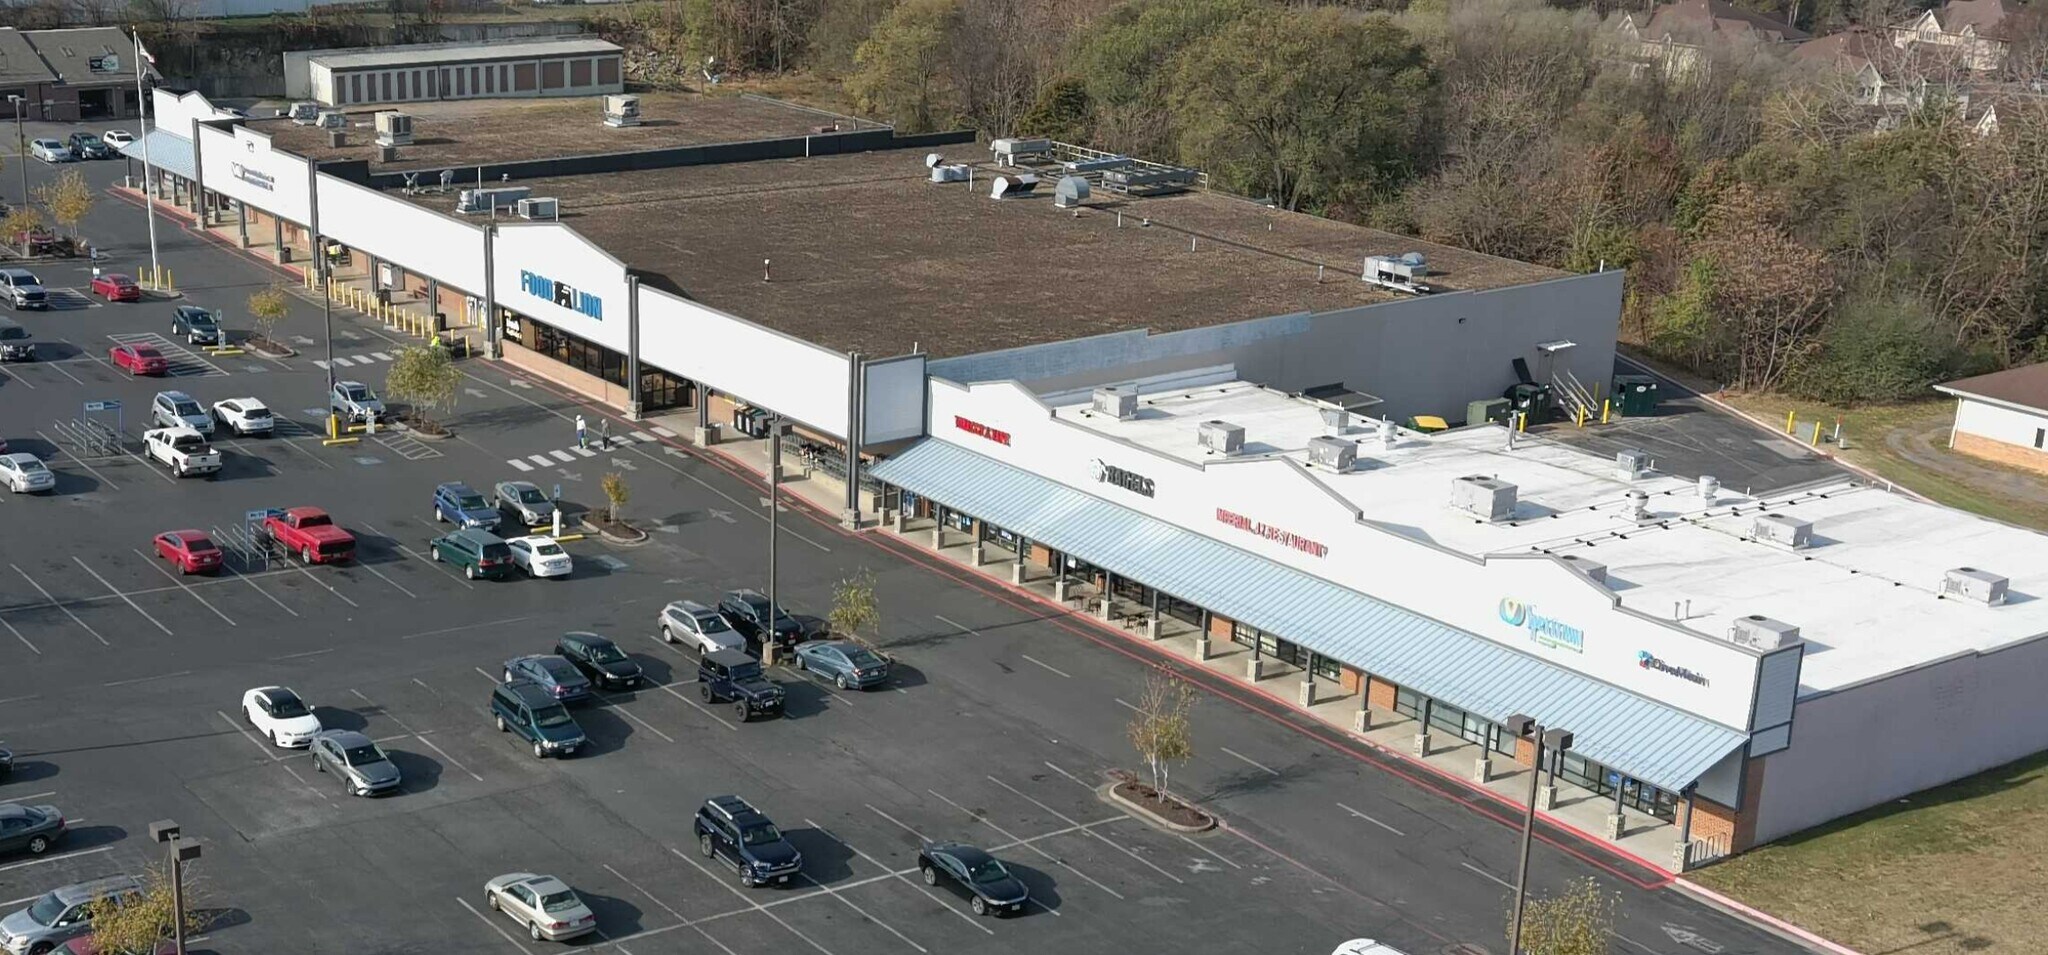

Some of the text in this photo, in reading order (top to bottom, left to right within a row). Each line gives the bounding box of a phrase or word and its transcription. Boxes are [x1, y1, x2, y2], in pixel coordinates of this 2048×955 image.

[521, 268, 603, 322] FOOD LION
[1106, 464, 1155, 499] BAGELS
